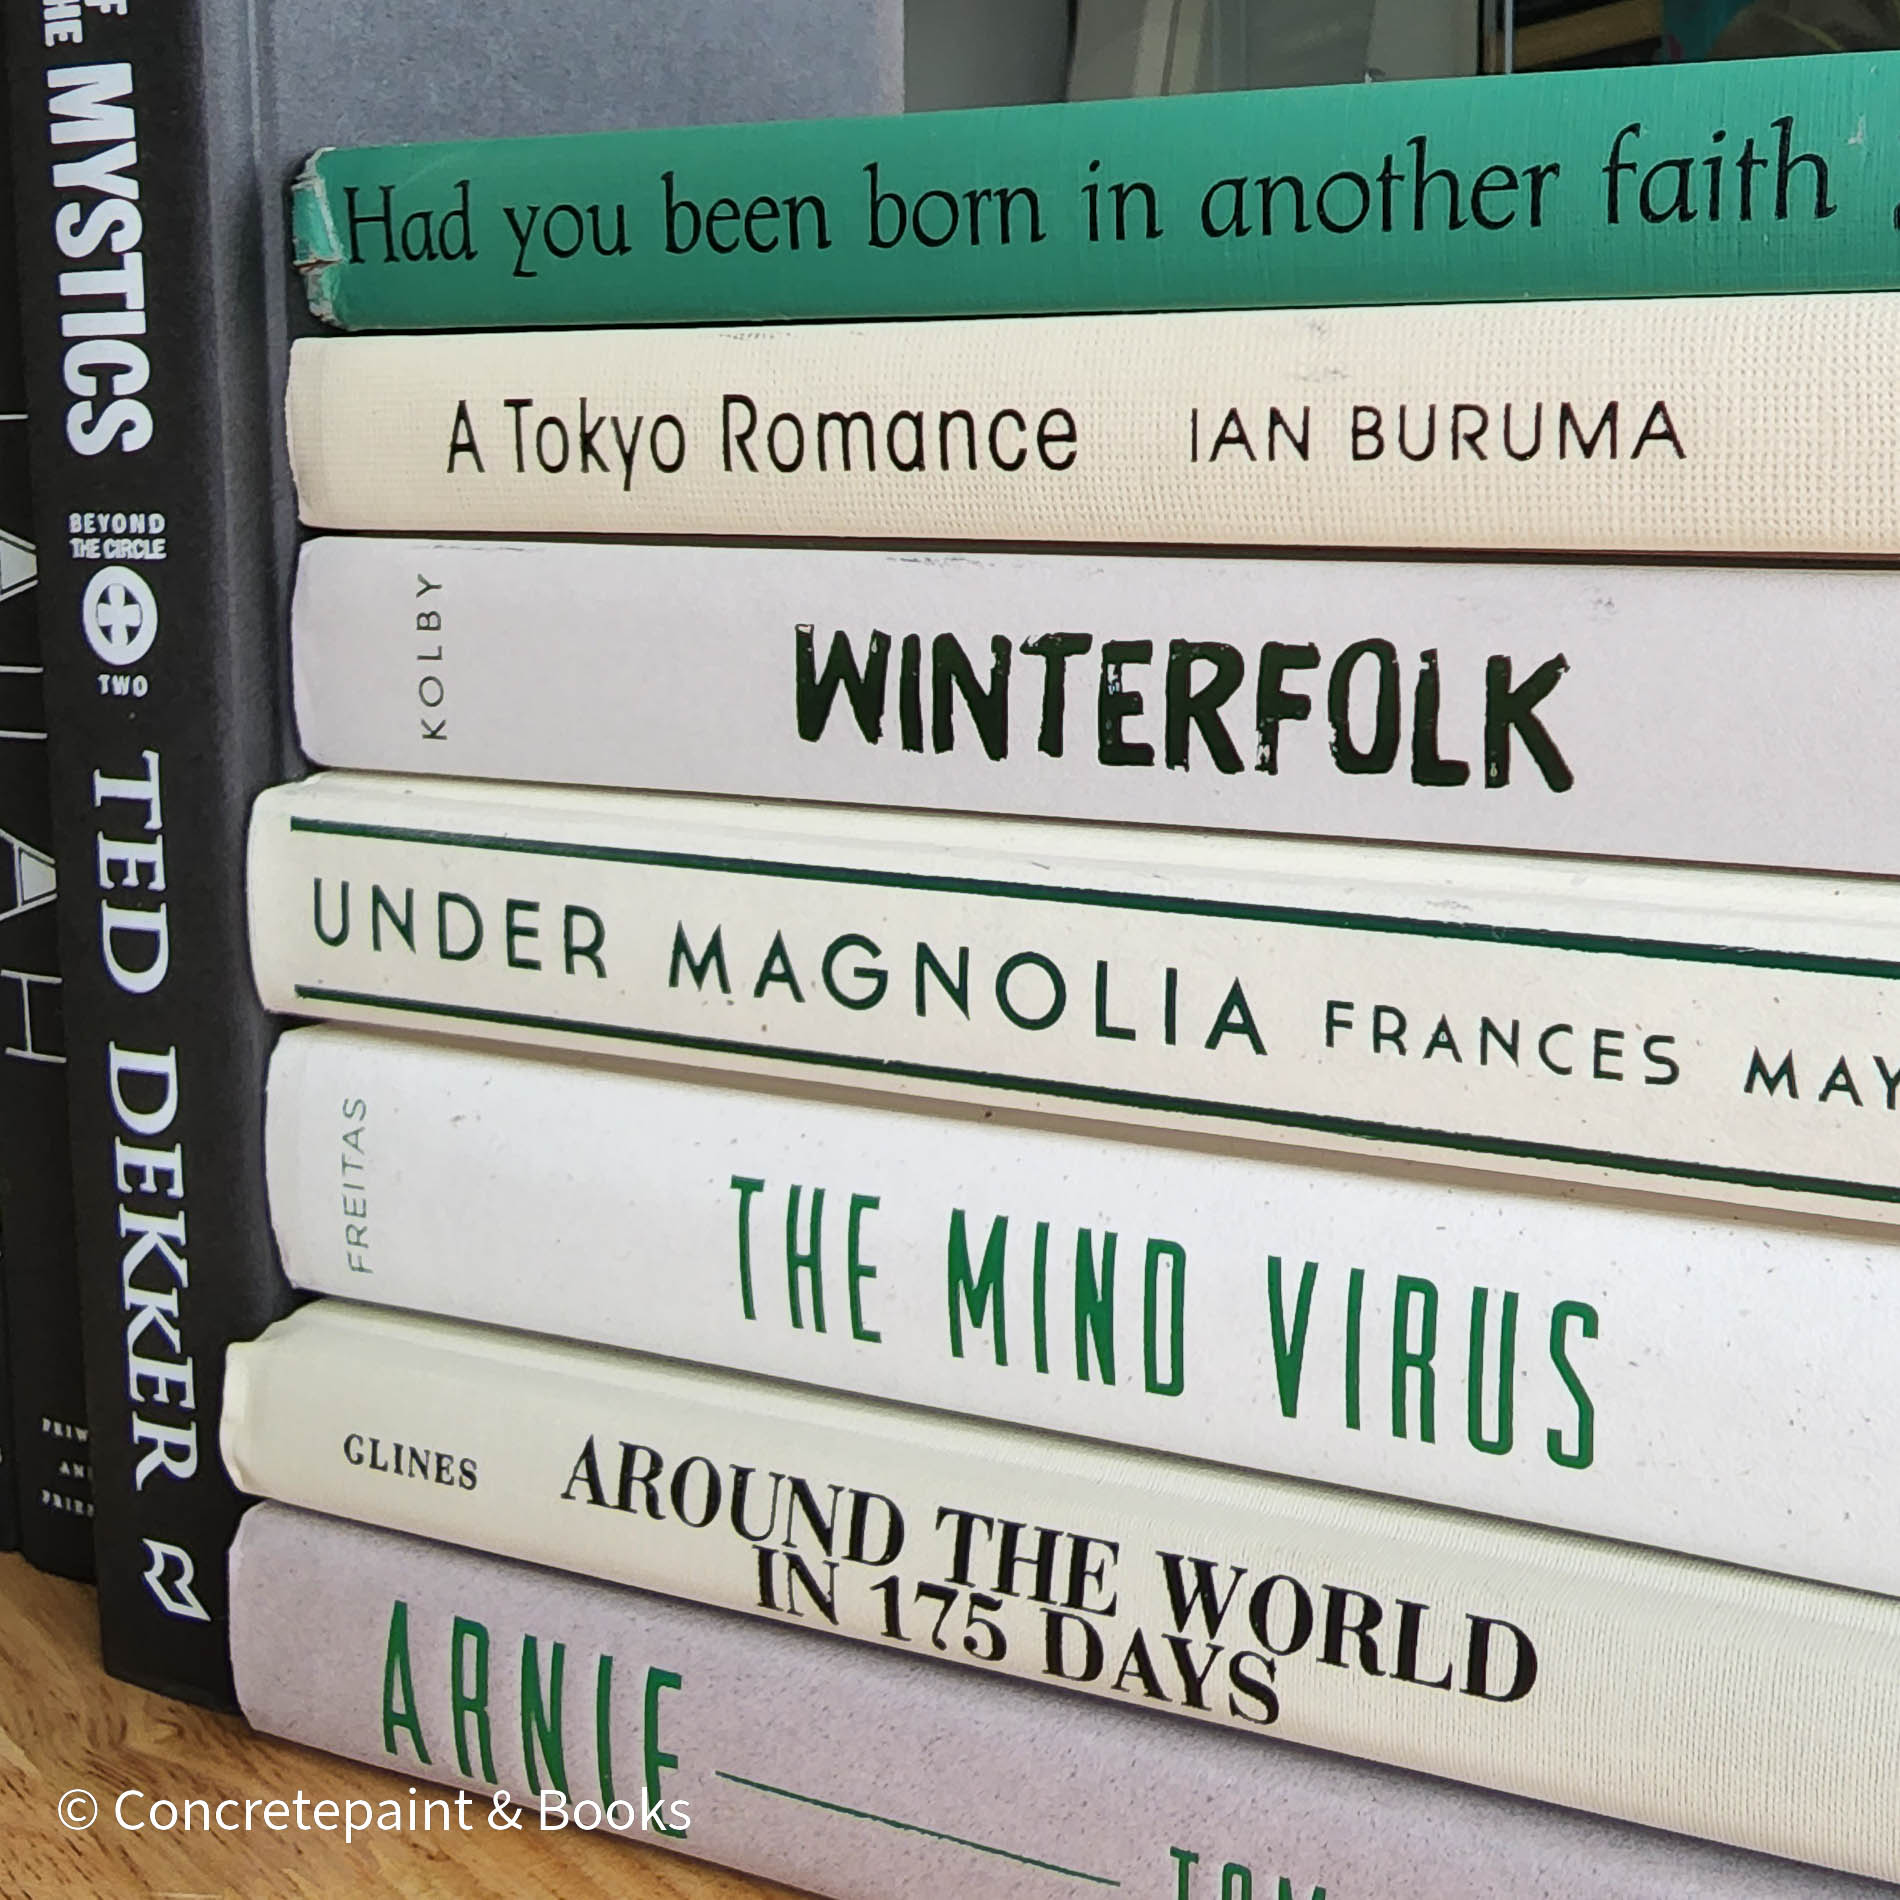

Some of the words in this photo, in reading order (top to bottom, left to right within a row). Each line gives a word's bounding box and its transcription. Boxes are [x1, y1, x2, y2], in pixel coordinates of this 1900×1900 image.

[47, 62, 154, 456] MYSTICS
[343, 179, 478, 265] Had
[502, 204, 633, 278] you
[660, 171, 832, 255] been
[863, 162, 1047, 249] born
[1081, 159, 1164, 242] in
[1201, 135, 1561, 238] another
[1602, 115, 1838, 225] faith
[446, 399, 485, 474] A
[503, 397, 686, 492] Tokyo
[722, 394, 1077, 473] Romance
[1191, 406, 1310, 463] IAN
[1351, 400, 1687, 462] BURUMA
[68, 512, 166, 535] BEYOND
[69, 537, 101, 559] THE
[102, 538, 168, 560] CIRCLE
[97, 674, 149, 698] TWO
[415, 574, 447, 740] KOLBY
[794, 623, 1574, 795] WINTERFOLK
[93, 750, 169, 993] TED
[313, 878, 607, 979] UNDER
[668, 922, 1268, 1056] MAGNOLIA
[1325, 999, 1680, 1086] FRANCES
[1743, 1045, 1900, 1110] MAY
[109, 1041, 199, 1491] DEKKER
[341, 1098, 373, 1274] FREITAS
[730, 1175, 882, 1344] THE
[947, 1207, 1187, 1397] MIND
[1267, 1255, 1599, 1470] VIRUS
[343, 1433, 477, 1491] GLINES
[560, 1434, 906, 1567] AROUND
[935, 1505, 1120, 1618] THE
[1155, 1550, 1539, 1704] WORLD
[752, 1543, 840, 1626] IN
[869, 1574, 1008, 1662] 175
[1039, 1606, 1280, 1727] DAYS
[381, 1599, 688, 1841] ARNIE
